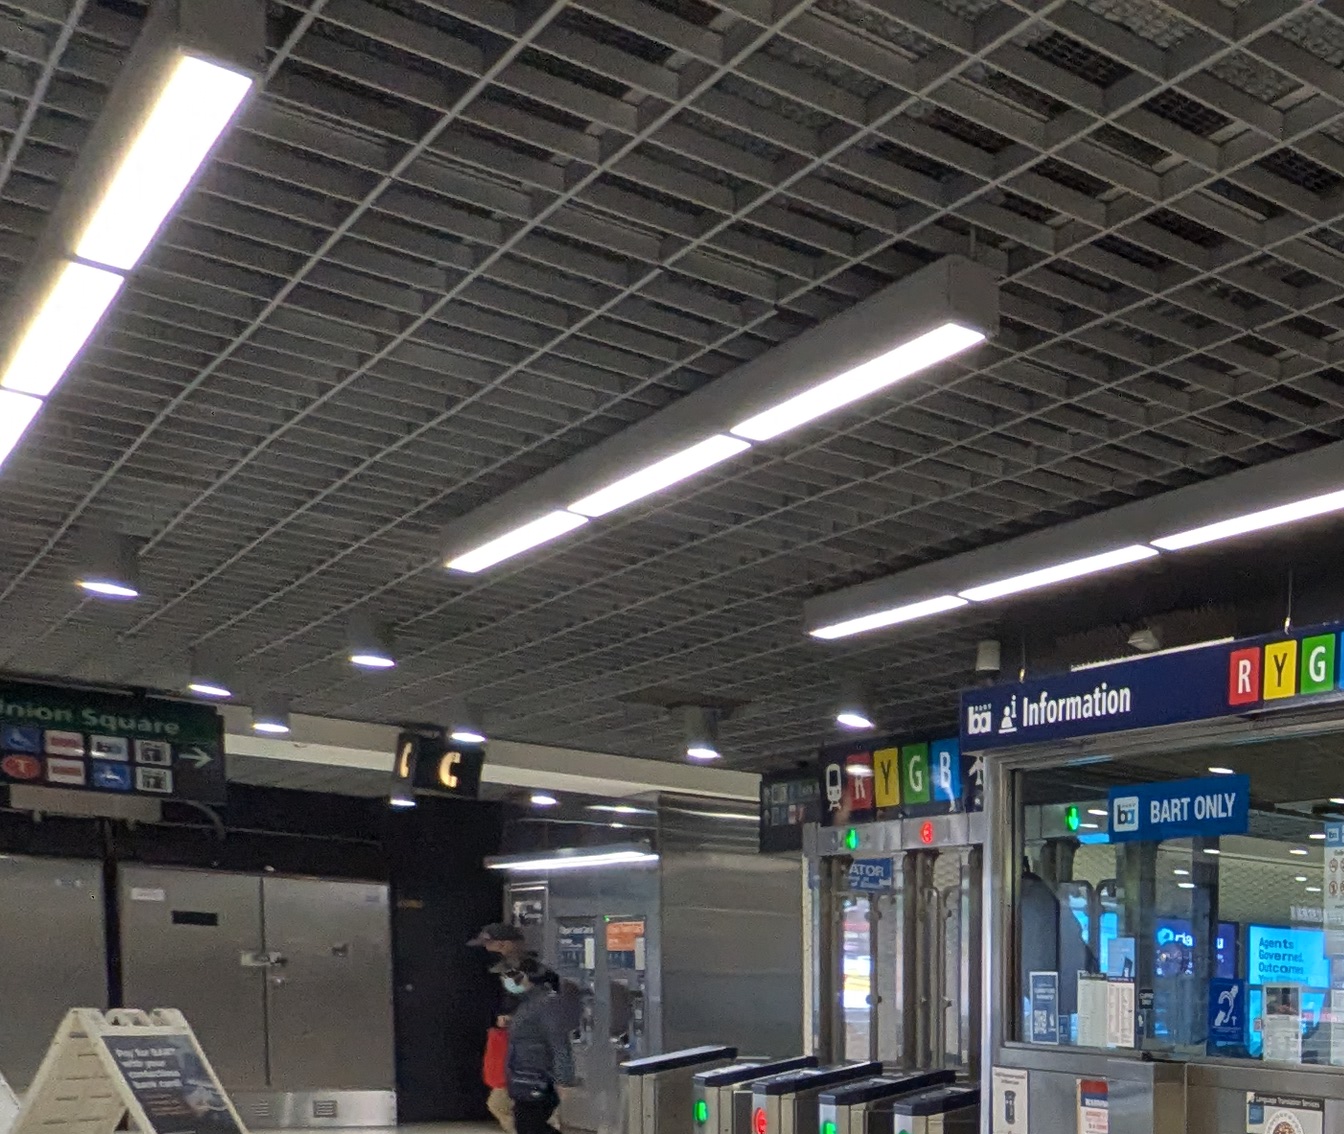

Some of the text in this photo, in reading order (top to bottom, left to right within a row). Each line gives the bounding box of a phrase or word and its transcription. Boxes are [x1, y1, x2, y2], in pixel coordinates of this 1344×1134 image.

[1238, 658, 1251, 693] R
[1273, 653, 1288, 687] Y
[1309, 646, 1325, 683] G
[0, 703, 181, 736] nion Square
[1022, 683, 1131, 727] Information
[880, 758, 892, 796] Y
[909, 754, 923, 792] G
[1150, 792, 1236, 824] BART ONLY
[848, 863, 884, 877] ATOR
[1259, 937, 1295, 949] Agents
